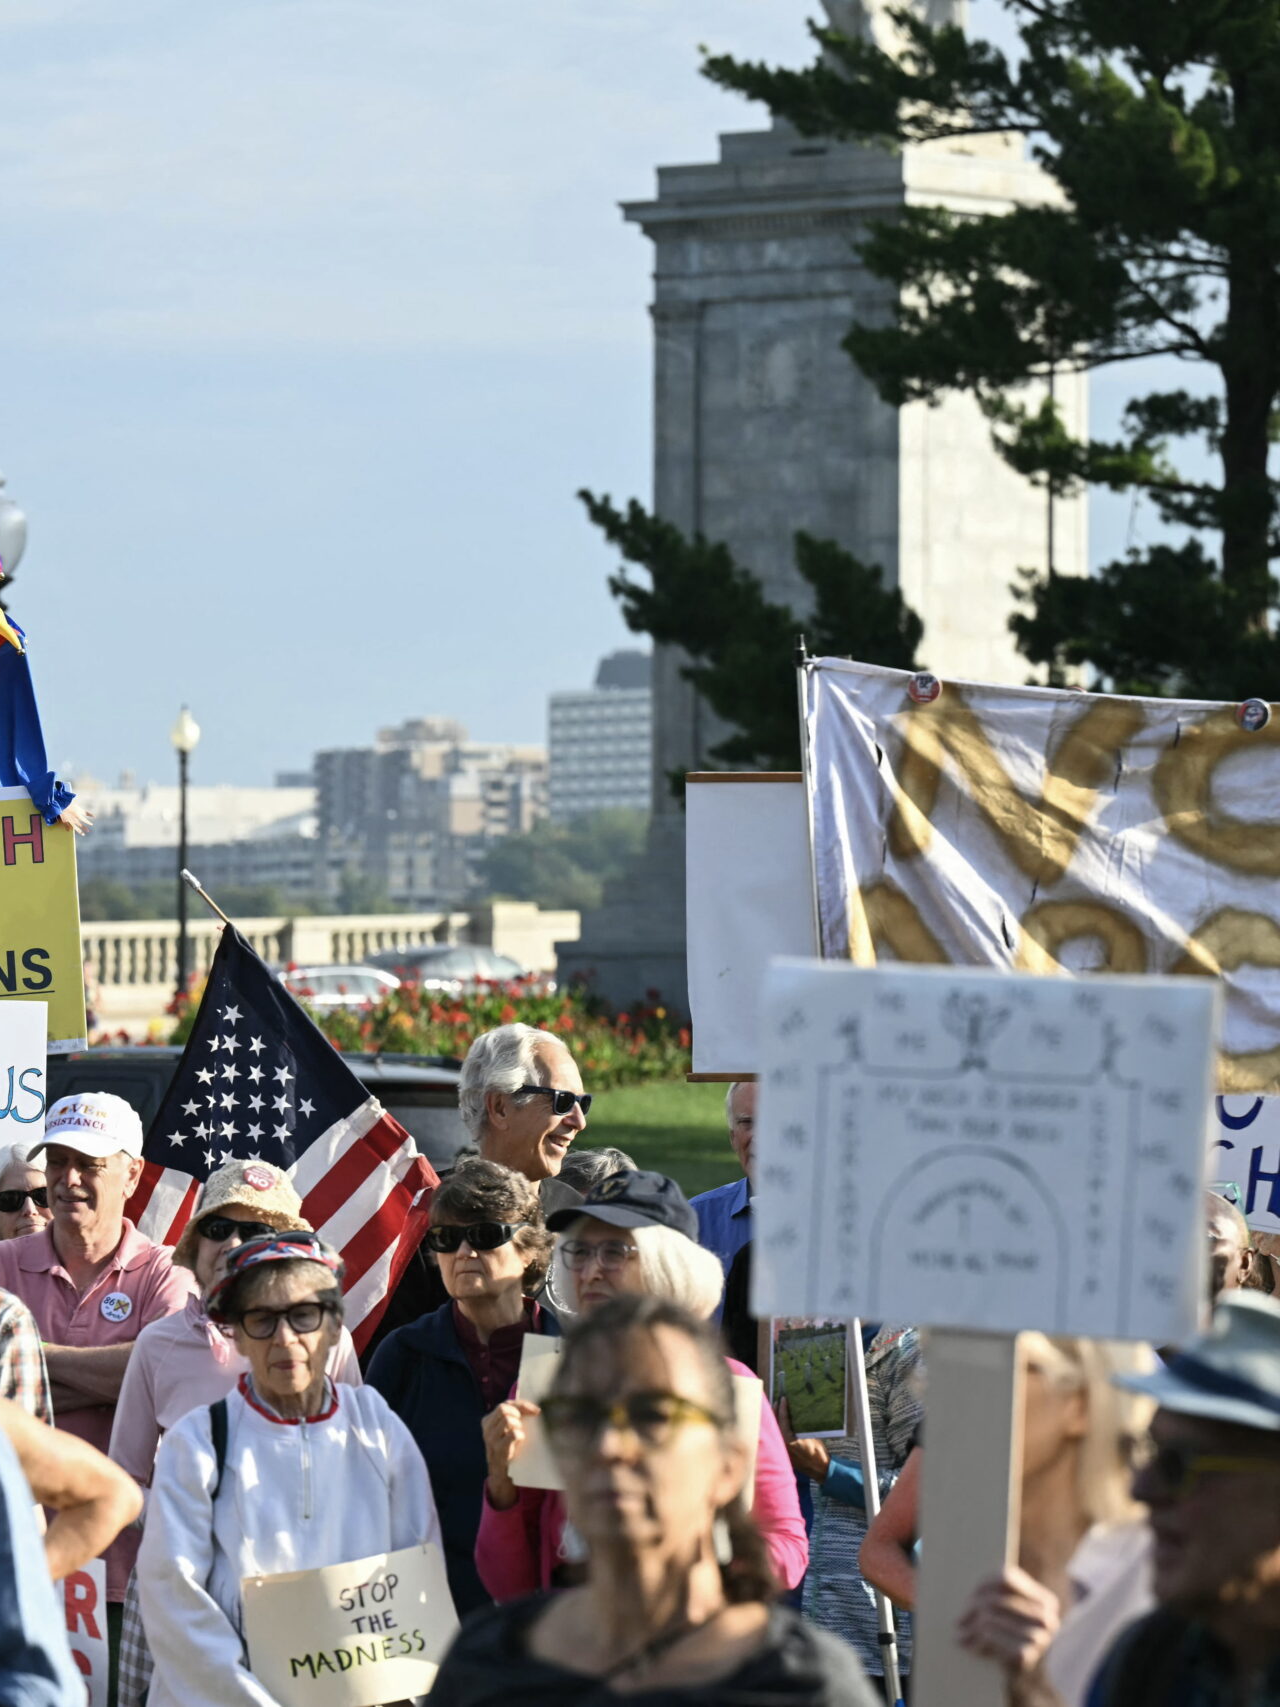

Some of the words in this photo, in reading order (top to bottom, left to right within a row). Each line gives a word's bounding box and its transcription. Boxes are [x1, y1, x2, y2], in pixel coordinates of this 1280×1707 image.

[247, 1174, 269, 1187] NO
[103, 1296, 115, 1306] 86
[339, 1573, 399, 1612] STOP
[351, 1609, 398, 1634] THE
[290, 1628, 426, 1679] MADNESS
